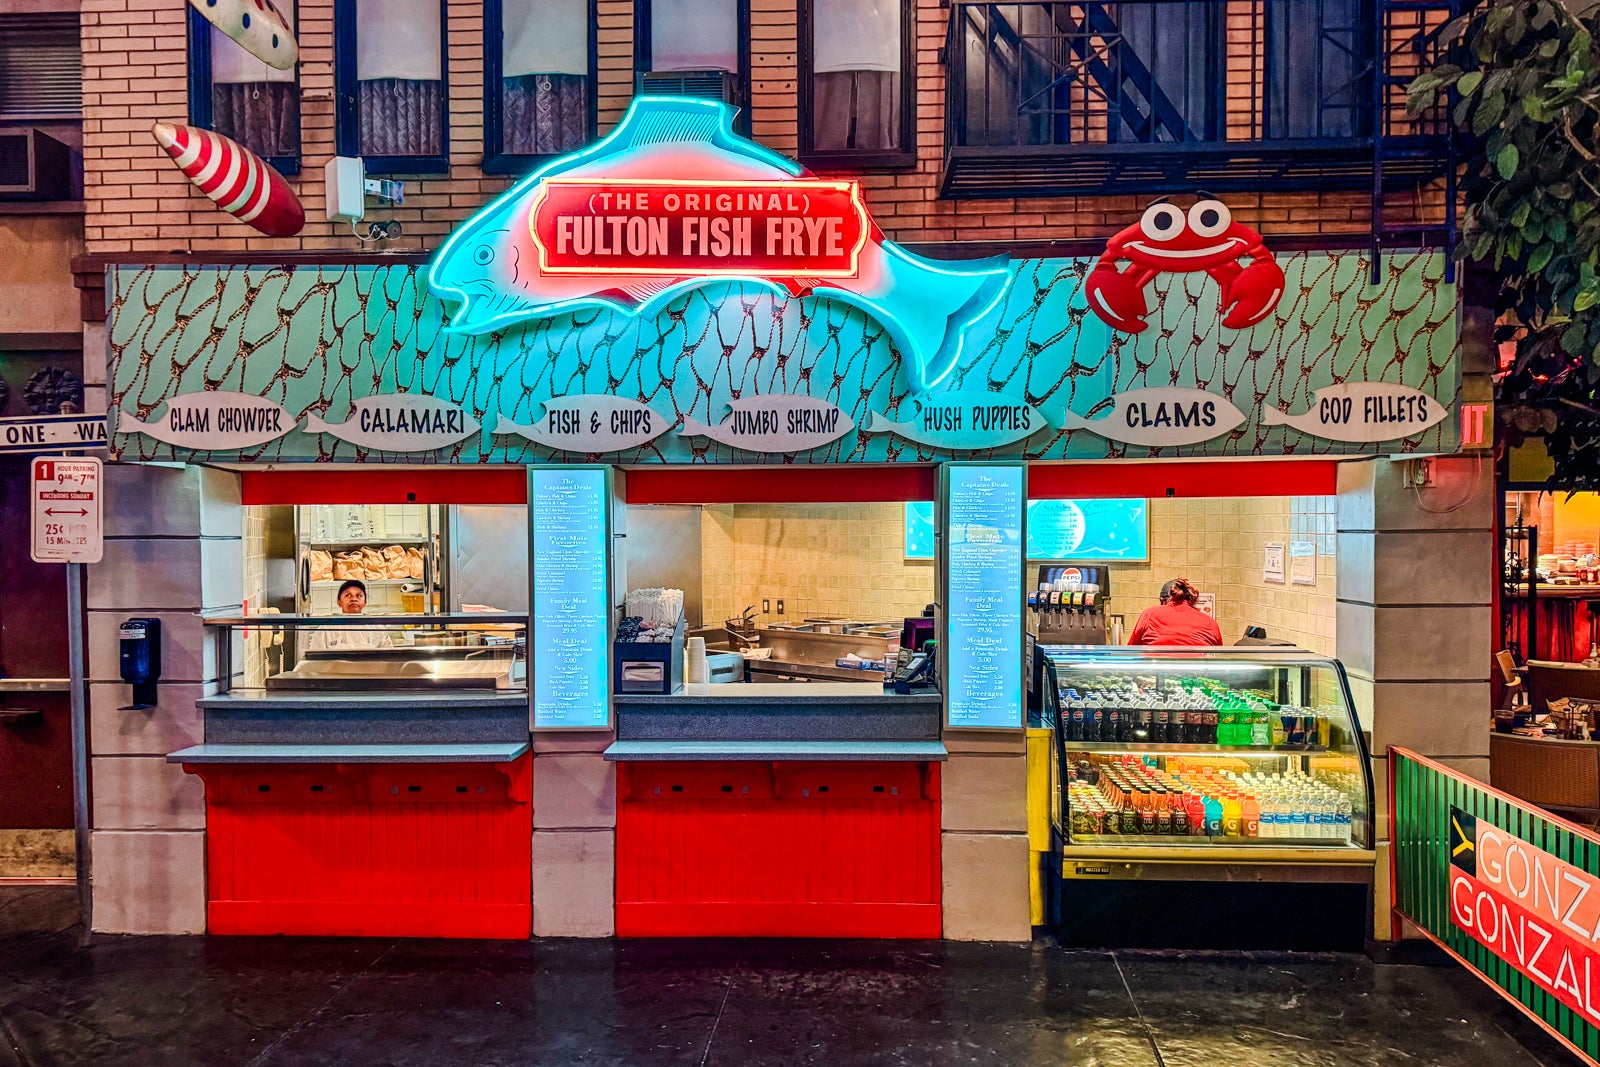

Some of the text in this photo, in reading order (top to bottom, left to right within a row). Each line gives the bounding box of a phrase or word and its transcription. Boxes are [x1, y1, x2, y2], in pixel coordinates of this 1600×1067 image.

[589, 193, 810, 214] (THE ORIGINAL)
[557, 216, 843, 257] FULTON FISH FRYE
[170, 407, 282, 433] CLAM CHOWDER
[923, 405, 1031, 432] HUSH PUPPIES
[1126, 401, 1216, 428] CLAMS
[1320, 395, 1428, 424] COD FILLETS
[360, 408, 464, 434] CALAMARI
[549, 409, 651, 434] FISH & CHIPS
[731, 408, 839, 435] JUMBO SHRIMP
[6, 425, 45, 444] ONE
[41, 464, 48, 479] 1
[551, 597, 570, 605] Family
[965, 596, 985, 604] Family
[552, 690, 588, 698] Beverages
[966, 689, 1003, 698] Beverages
[1210, 820, 1219, 830] G
[1228, 820, 1237, 830] G
[1248, 821, 1257, 831] G
[1480, 831, 1600, 944] GONZ
